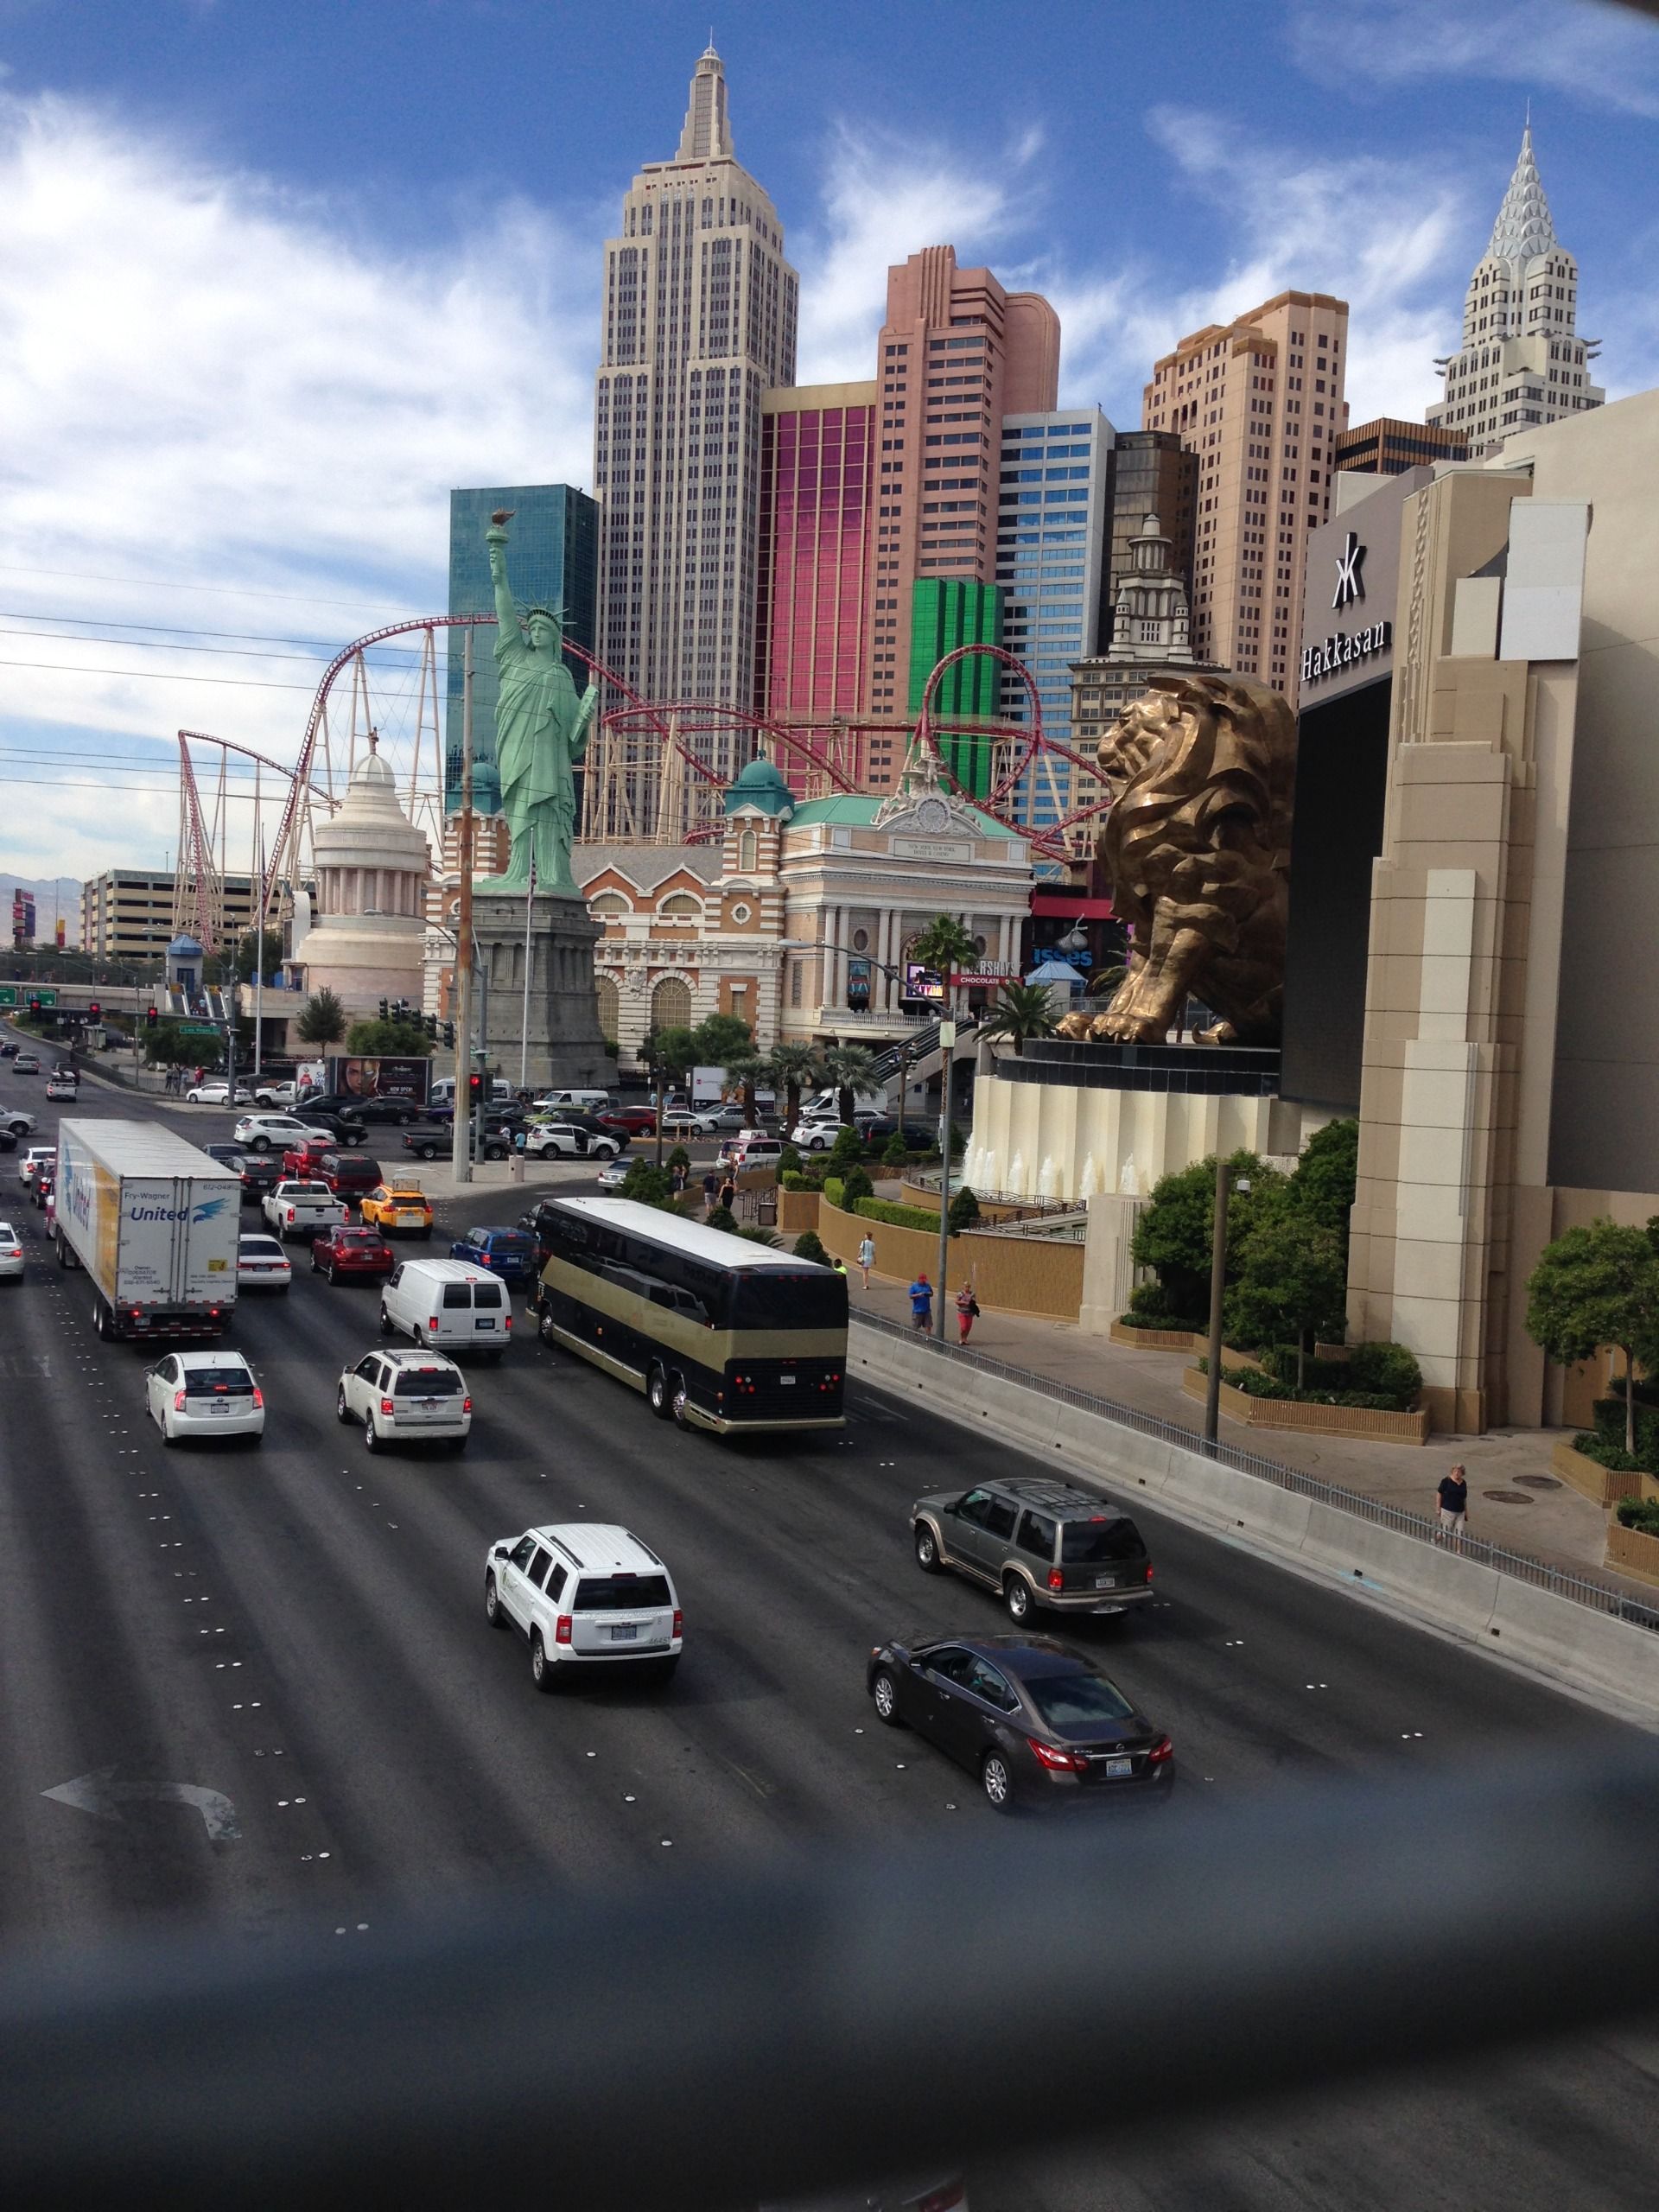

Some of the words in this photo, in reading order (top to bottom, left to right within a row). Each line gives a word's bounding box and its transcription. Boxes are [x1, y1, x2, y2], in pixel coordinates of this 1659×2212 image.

[1301, 620, 1384, 682] Hakkasan
[124, 1192, 170, 1200] Fry-Wagner
[130, 1206, 189, 1221] United
